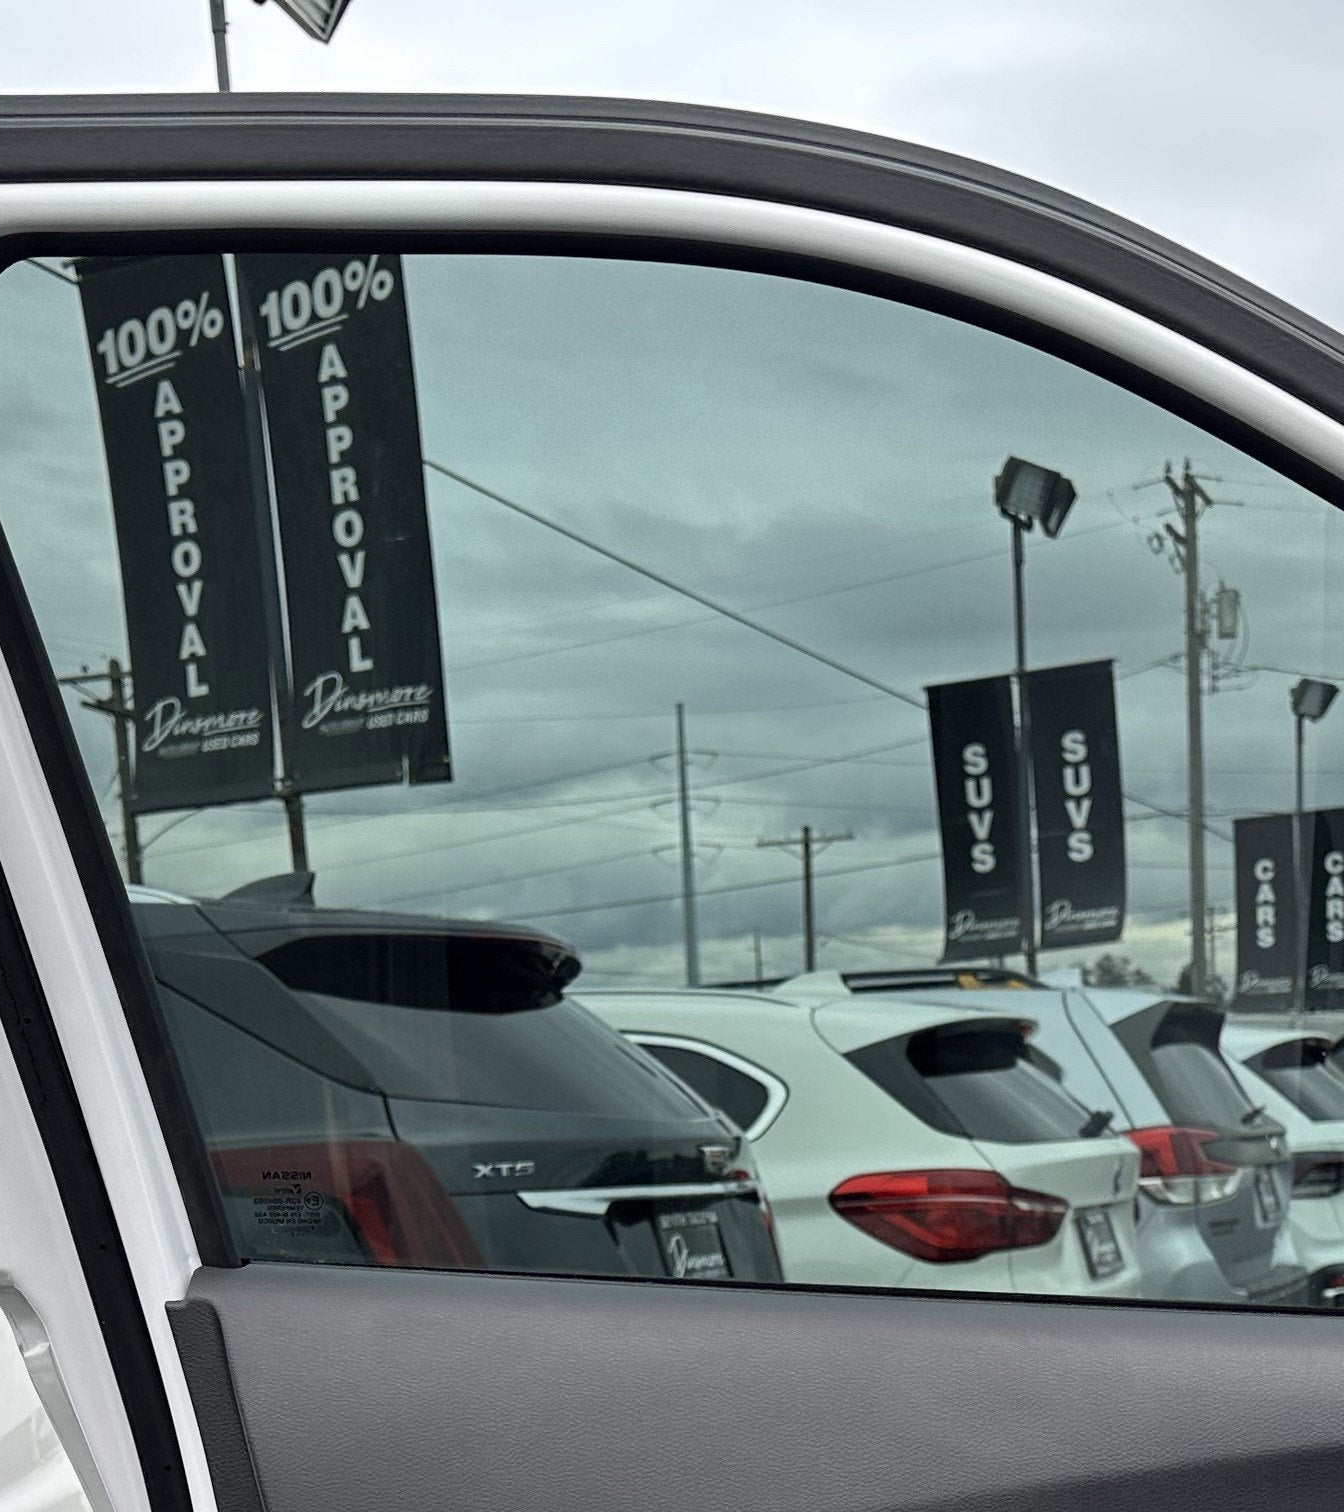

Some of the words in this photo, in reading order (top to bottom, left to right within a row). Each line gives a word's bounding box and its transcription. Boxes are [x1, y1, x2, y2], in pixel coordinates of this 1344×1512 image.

[96, 290, 224, 375] 100%
[259, 254, 394, 341] 100%
[153, 378, 209, 698] APPROVAL
[316, 343, 374, 673] APPROVAL
[961, 742, 997, 874] SUVS
[1060, 729, 1094, 864] SUVS
[1253, 857, 1276, 950] CARS
[472, 1161, 535, 1179] XT5
